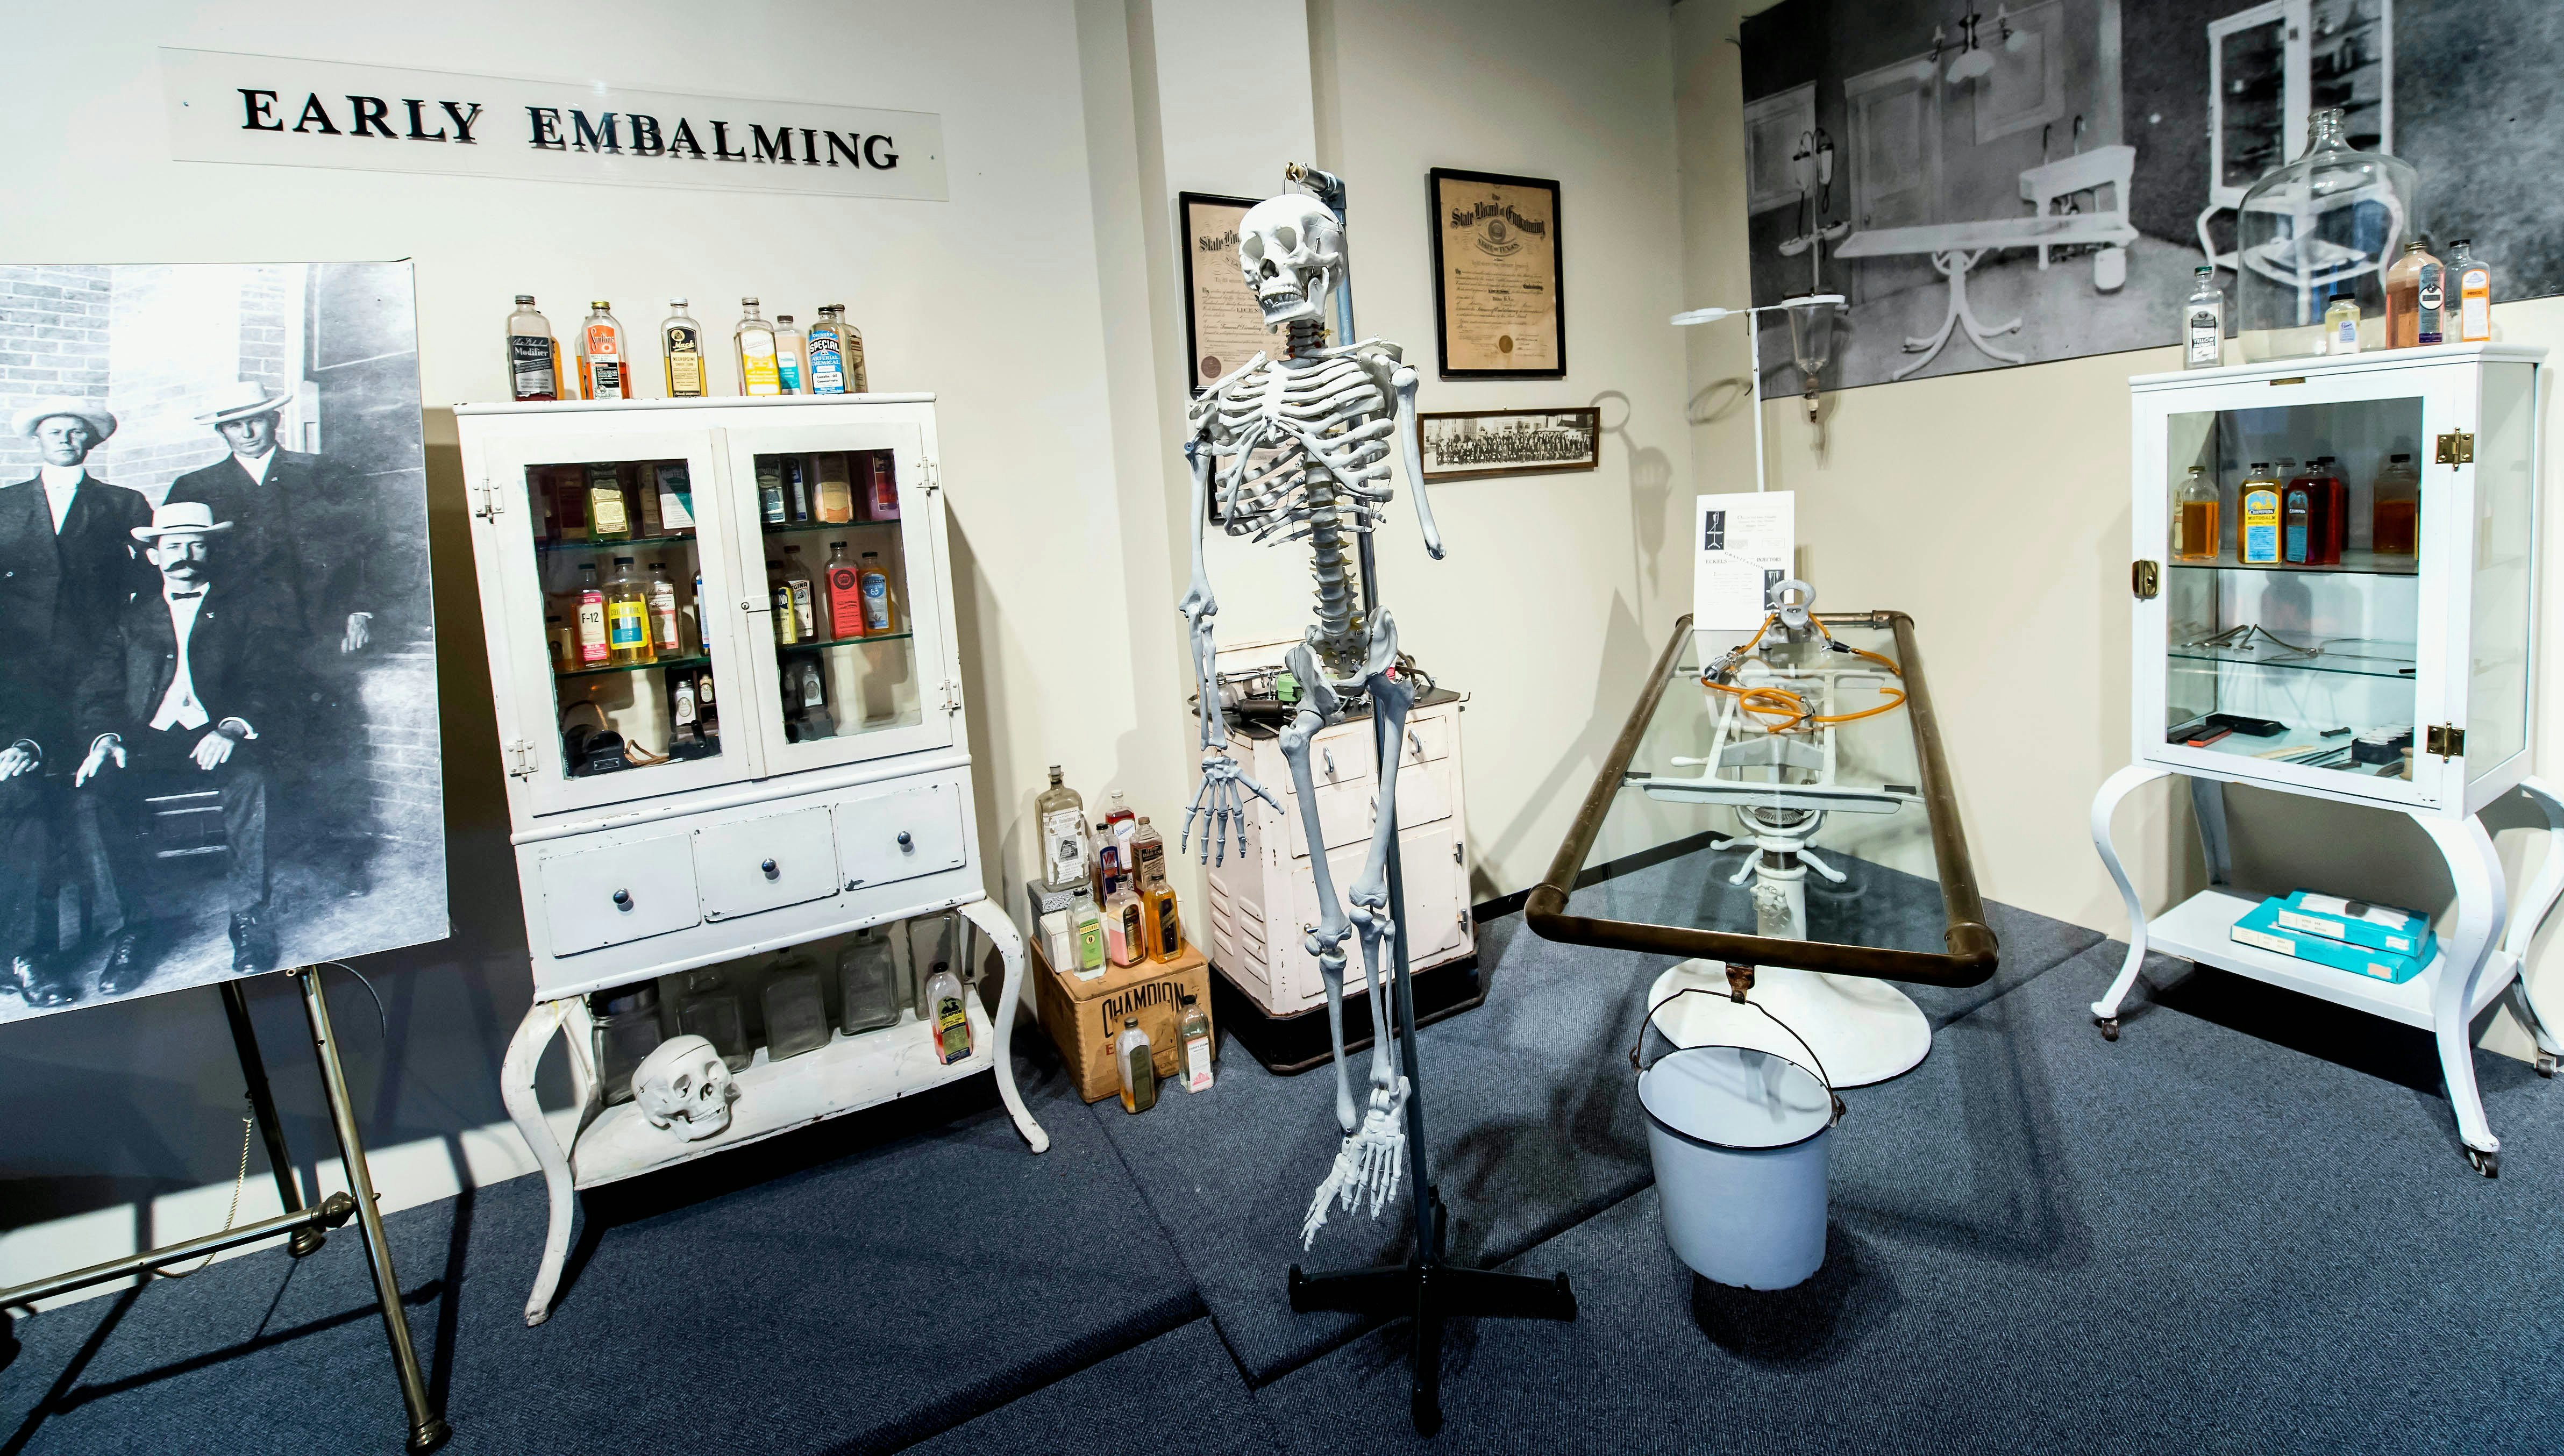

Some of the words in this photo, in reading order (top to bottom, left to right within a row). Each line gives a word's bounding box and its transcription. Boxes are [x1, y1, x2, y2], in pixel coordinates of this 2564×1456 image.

[237, 88, 480, 142] EARLY
[524, 105, 900, 169] EMBALMING
[1451, 207, 1475, 229] State
[1473, 201, 1499, 219] Board
[1506, 205, 1546, 241] Embalming
[1199, 236, 1223, 252] State
[1499, 242, 1520, 253] TEXAS
[673, 339, 695, 349] Mack
[810, 339, 839, 353] SPECIAL
[515, 346, 549, 356] Modifier
[1725, 551, 1764, 570] GRAVITATION
[792, 582, 808, 591] EGINA
[581, 612, 600, 624] F-12
[1103, 851, 1116, 865] VX
[940, 1009, 963, 1020] CHAMPION
